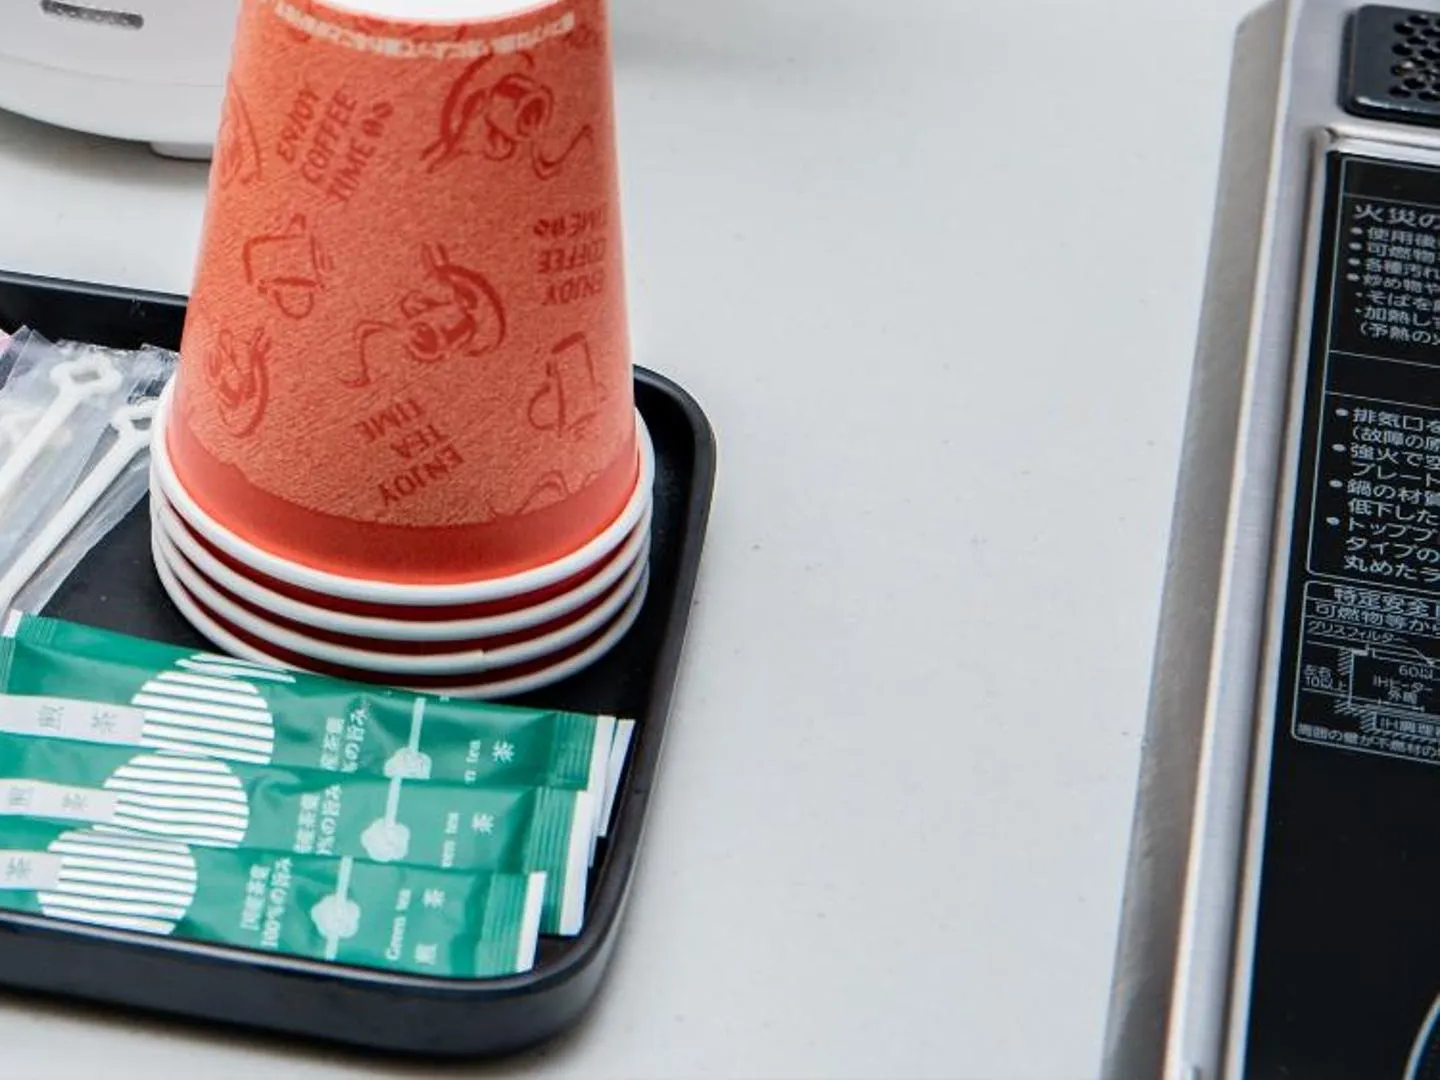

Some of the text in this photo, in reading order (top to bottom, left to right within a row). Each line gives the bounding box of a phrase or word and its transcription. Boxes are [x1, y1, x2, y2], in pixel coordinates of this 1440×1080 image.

[276, 89, 320, 164] ENJOY
[302, 90, 357, 184] COFFEE
[327, 137, 377, 201] TIME
[1366, 242, 1440, 264] 可燃物
[356, 399, 425, 442] TIME
[390, 424, 448, 458] TEA
[378, 443, 465, 507] ENJOY
